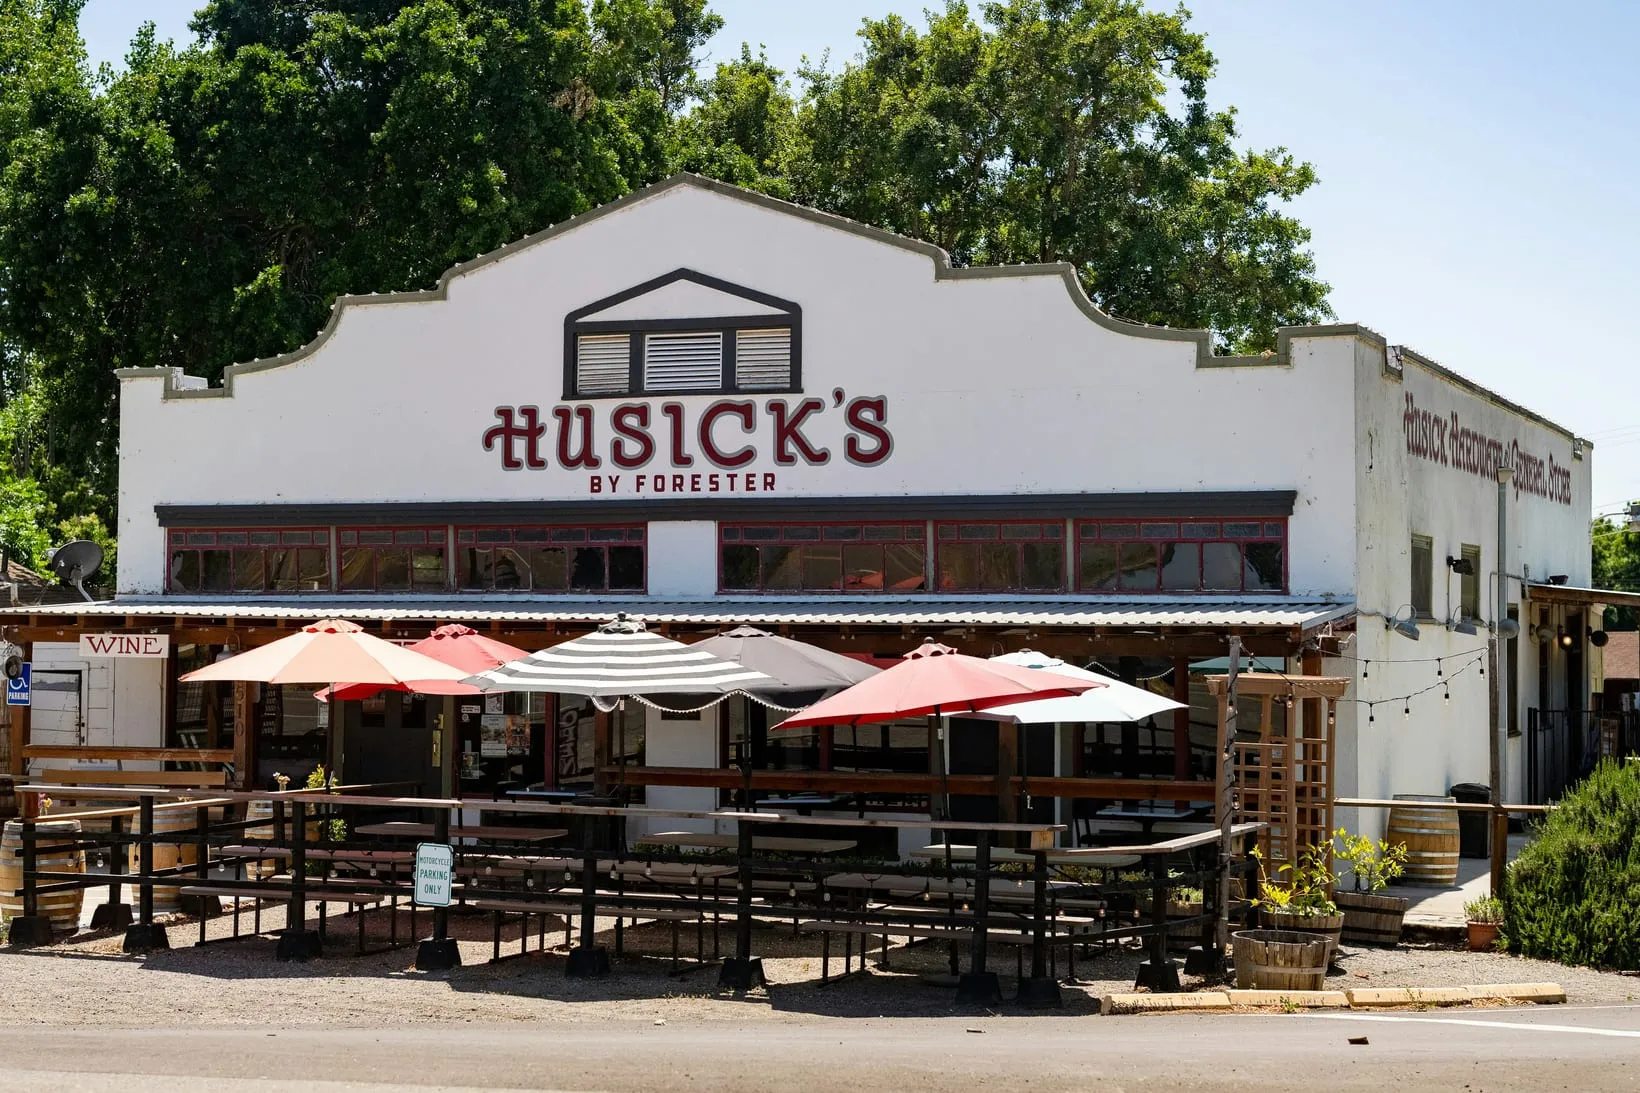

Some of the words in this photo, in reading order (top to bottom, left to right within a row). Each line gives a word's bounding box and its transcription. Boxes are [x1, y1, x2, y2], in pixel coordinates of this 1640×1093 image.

[482, 387, 894, 471] HUSICK'S
[1403, 391, 1448, 467] HUSICK
[1511, 438, 1547, 501] GENERAL
[1548, 451, 1571, 505] STORE
[590, 475, 620, 494] BY
[635, 472, 777, 493] FORESTER
[85, 636, 163, 654] WINE
[8, 691, 29, 701] PARKING
[419, 856, 450, 866] MOTORCYCLE
[420, 869, 448, 881] PARKING
[424, 883, 442, 895] ONLY
